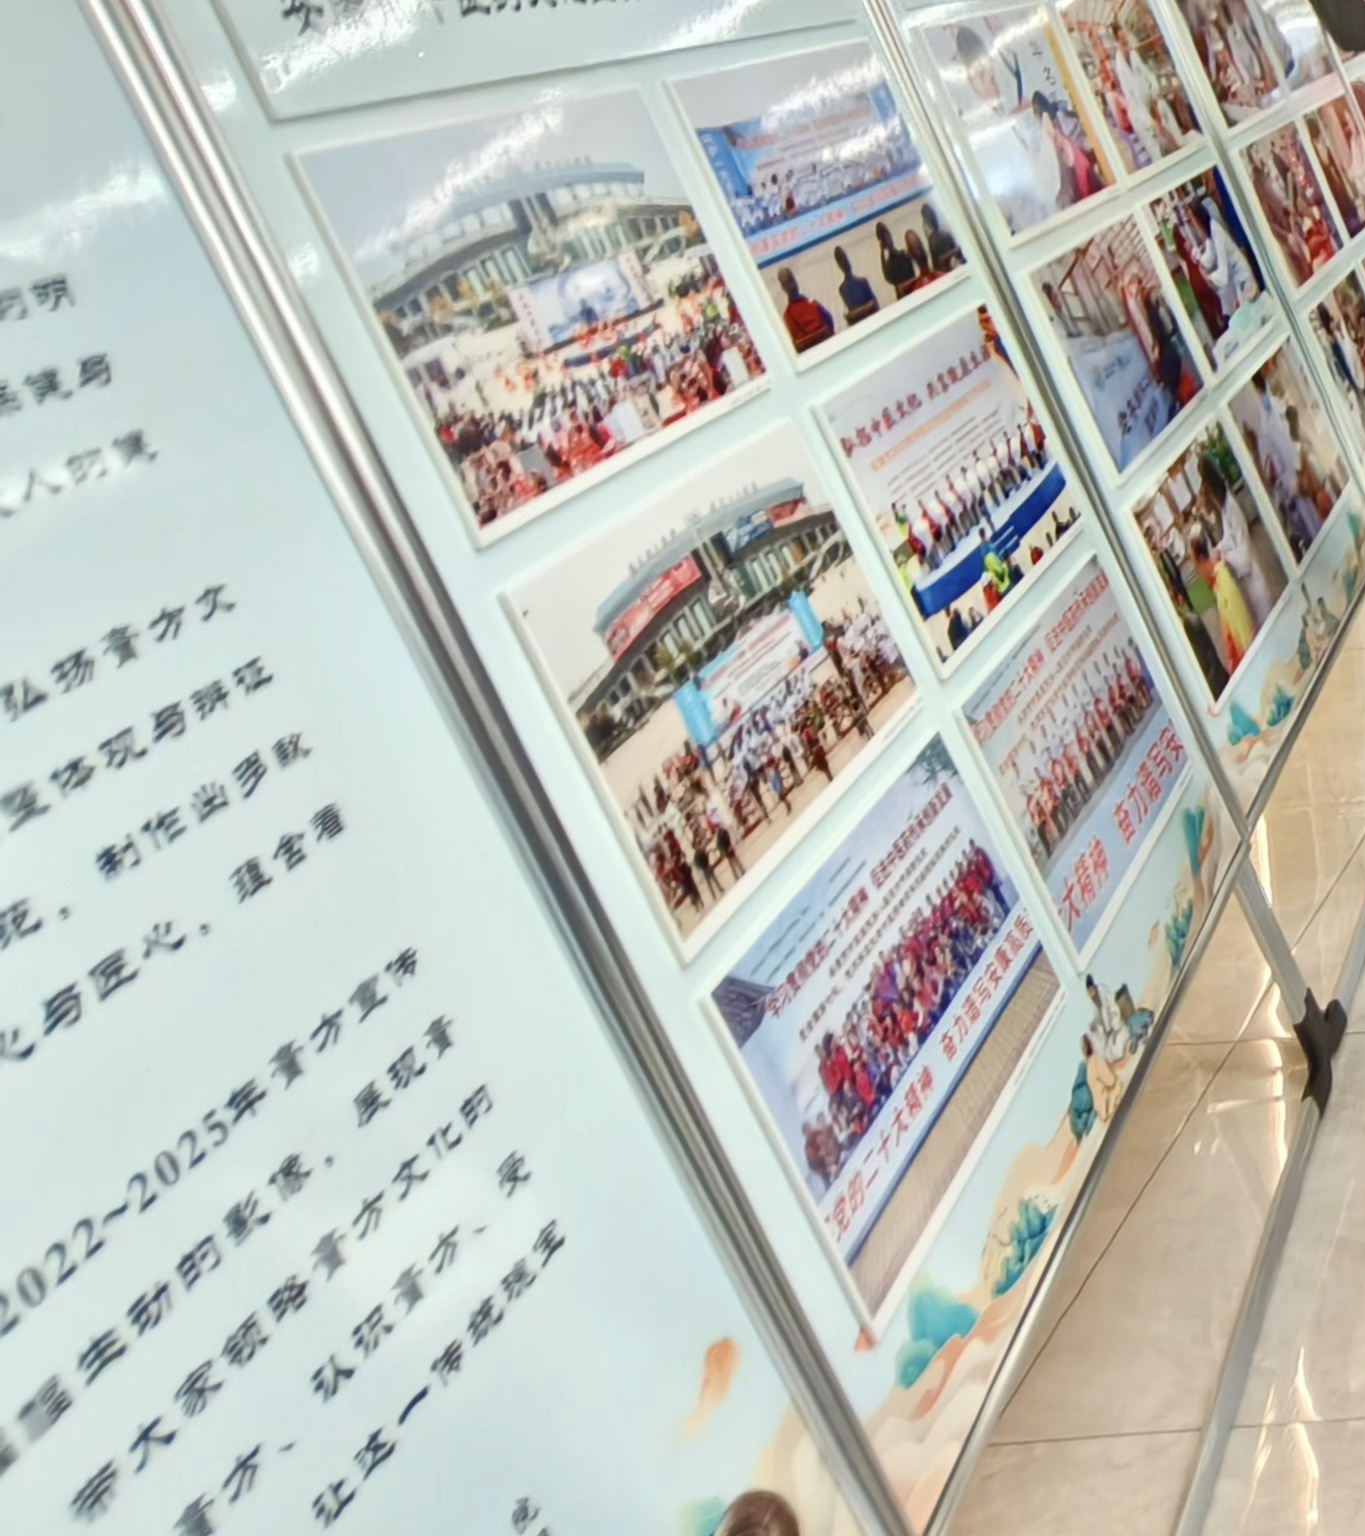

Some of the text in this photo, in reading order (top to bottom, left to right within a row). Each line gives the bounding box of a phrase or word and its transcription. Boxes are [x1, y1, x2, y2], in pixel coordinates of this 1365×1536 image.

[824, 1064, 937, 1246] 党的二十大精神
[937, 905, 1036, 1064] 奋力谱写安康高质
